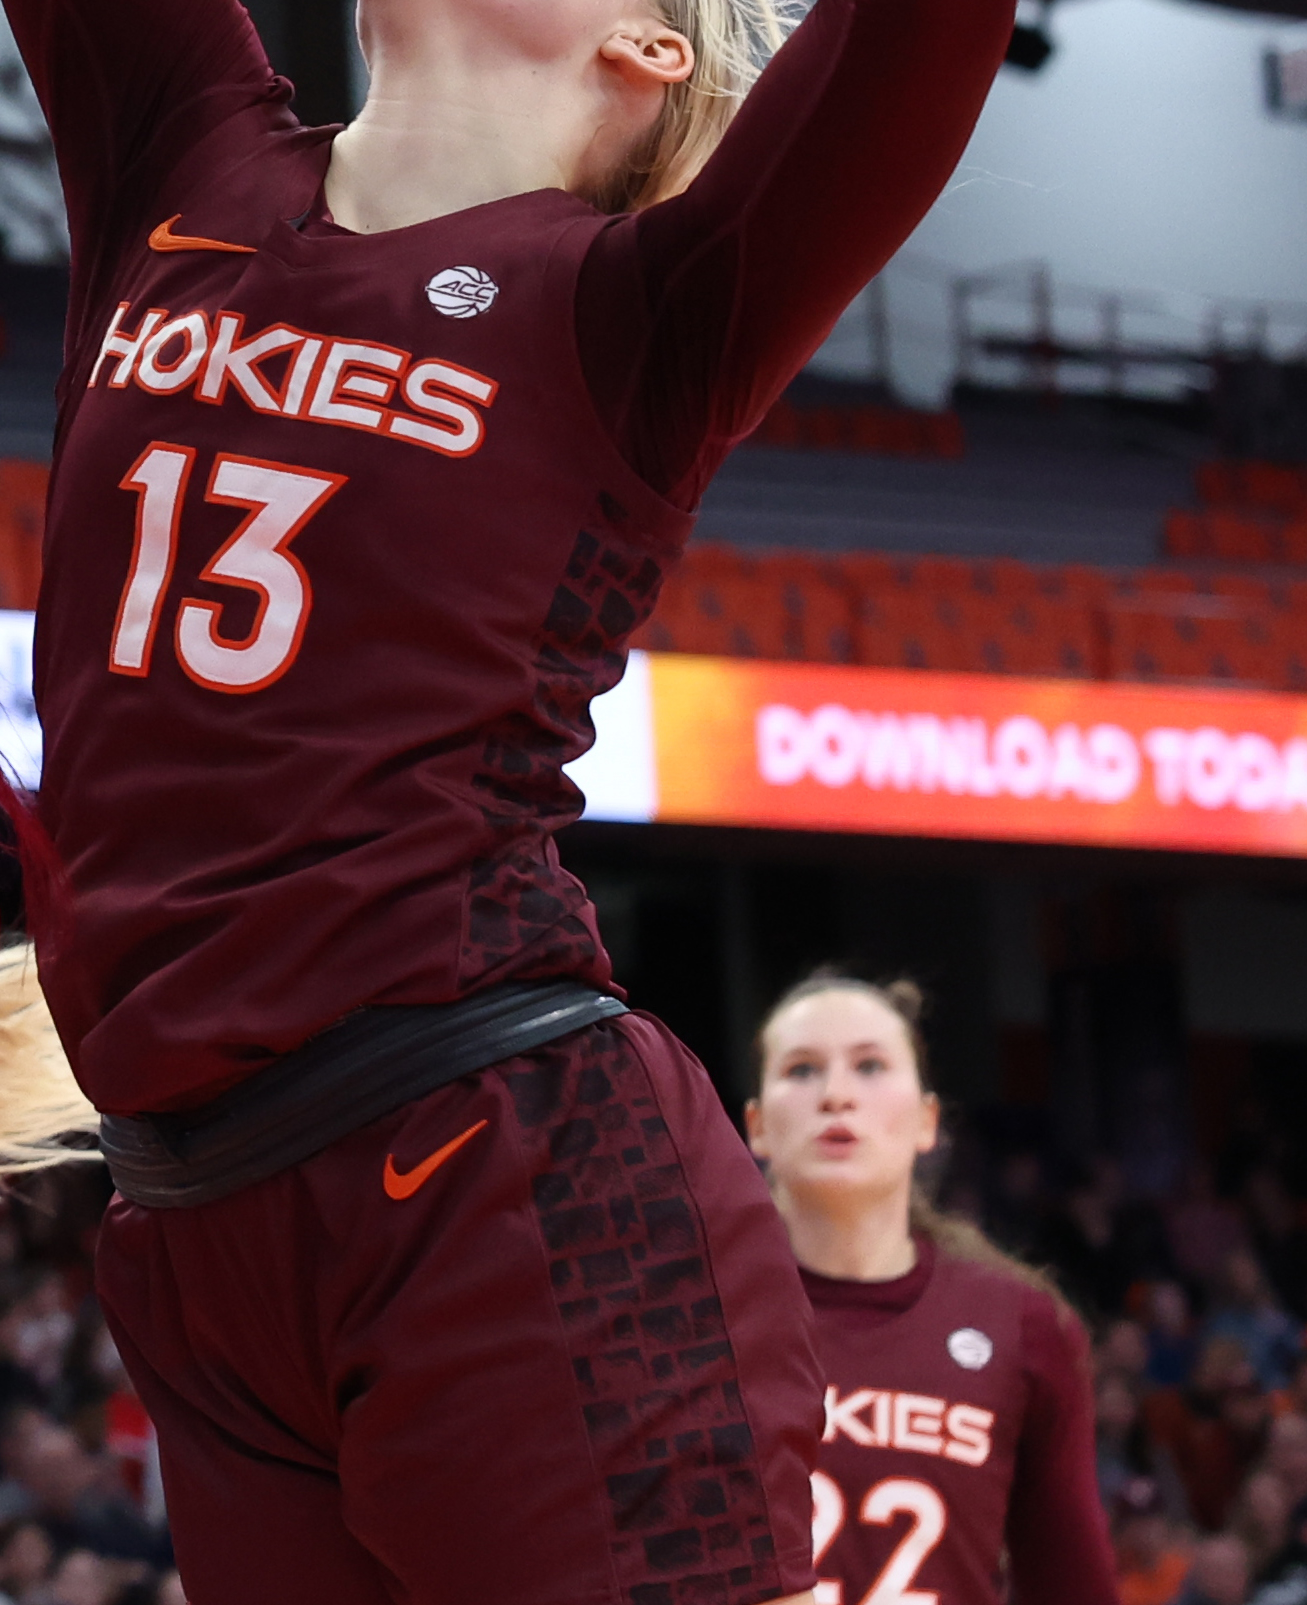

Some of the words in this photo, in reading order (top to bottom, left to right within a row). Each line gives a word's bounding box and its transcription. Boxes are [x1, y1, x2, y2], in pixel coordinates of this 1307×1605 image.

[436, 280, 495, 300] ACC
[88, 301, 499, 457] HOKIES
[109, 441, 349, 694] 13
[757, 704, 1140, 804] DOWNLOAD
